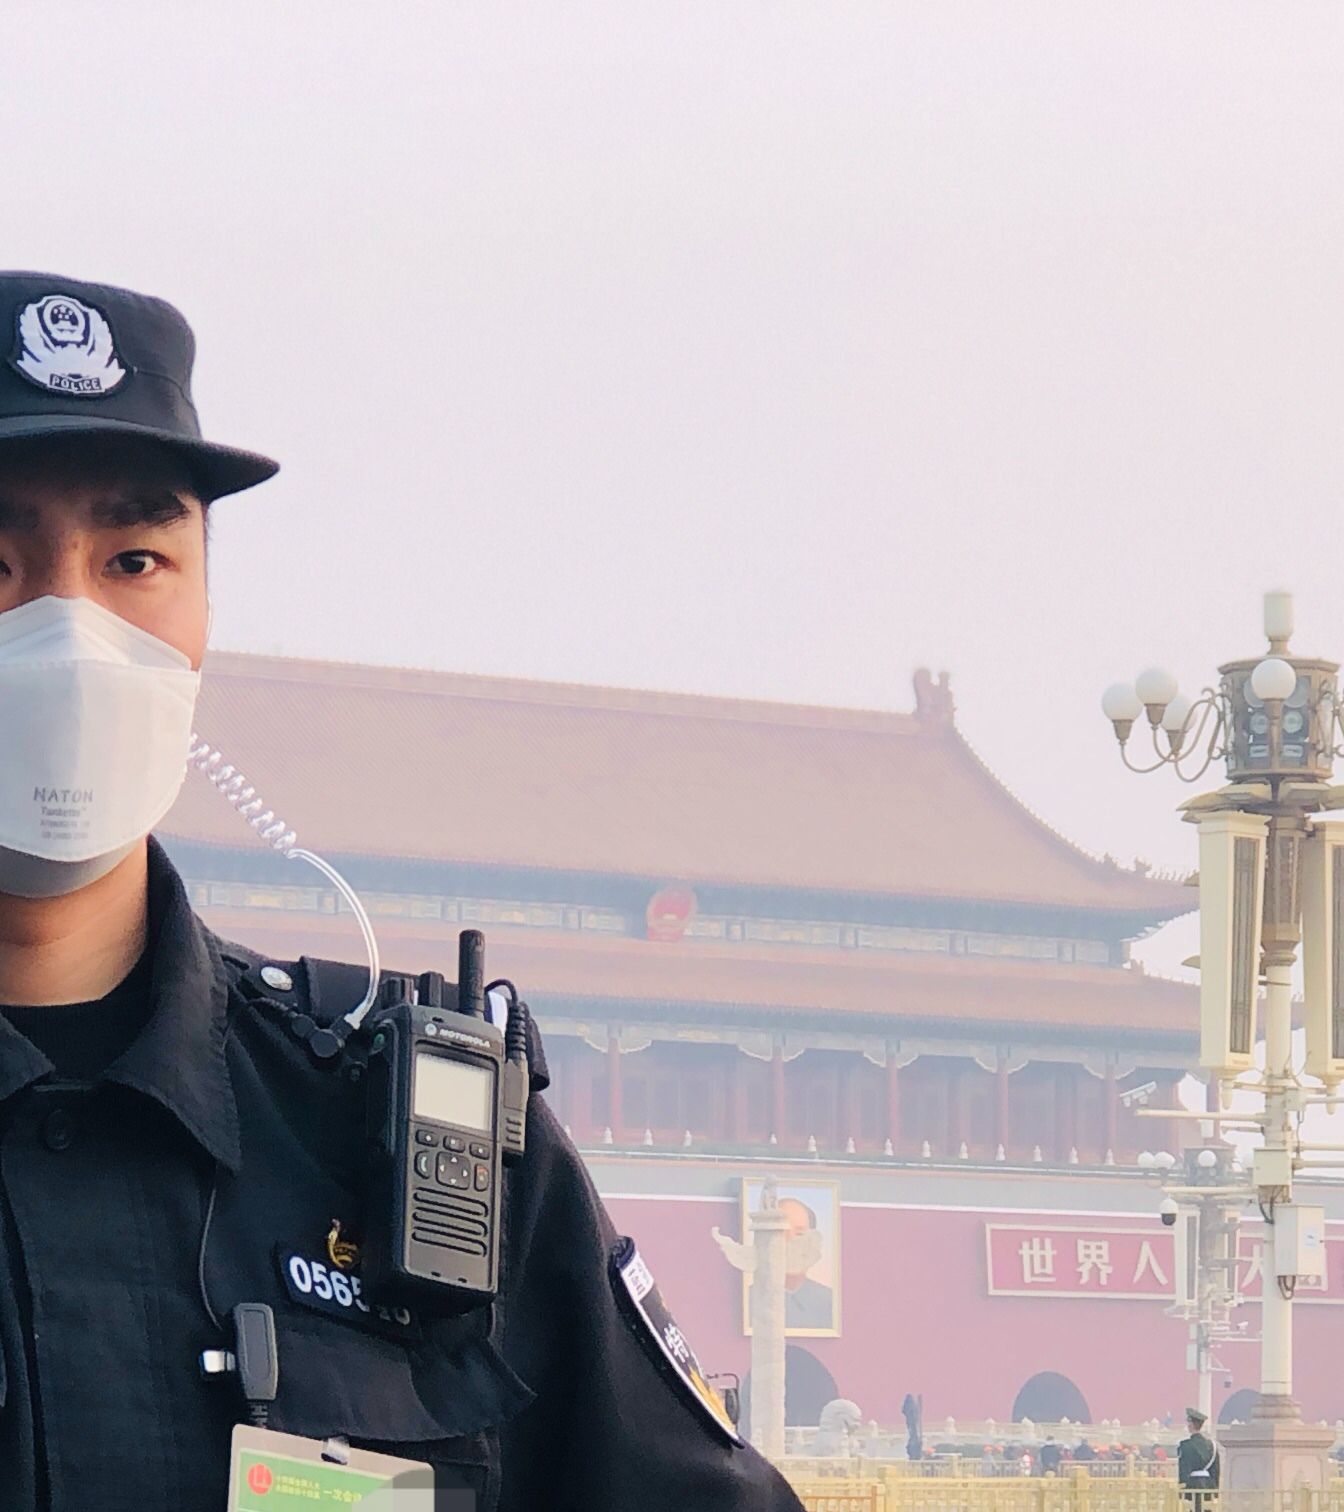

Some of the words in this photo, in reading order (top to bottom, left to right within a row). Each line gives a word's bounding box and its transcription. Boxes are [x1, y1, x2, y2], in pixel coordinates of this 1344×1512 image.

[51, 375, 100, 391] POLICE
[33, 786, 93, 804] NATON
[439, 1028, 491, 1049] MOTOROLA
